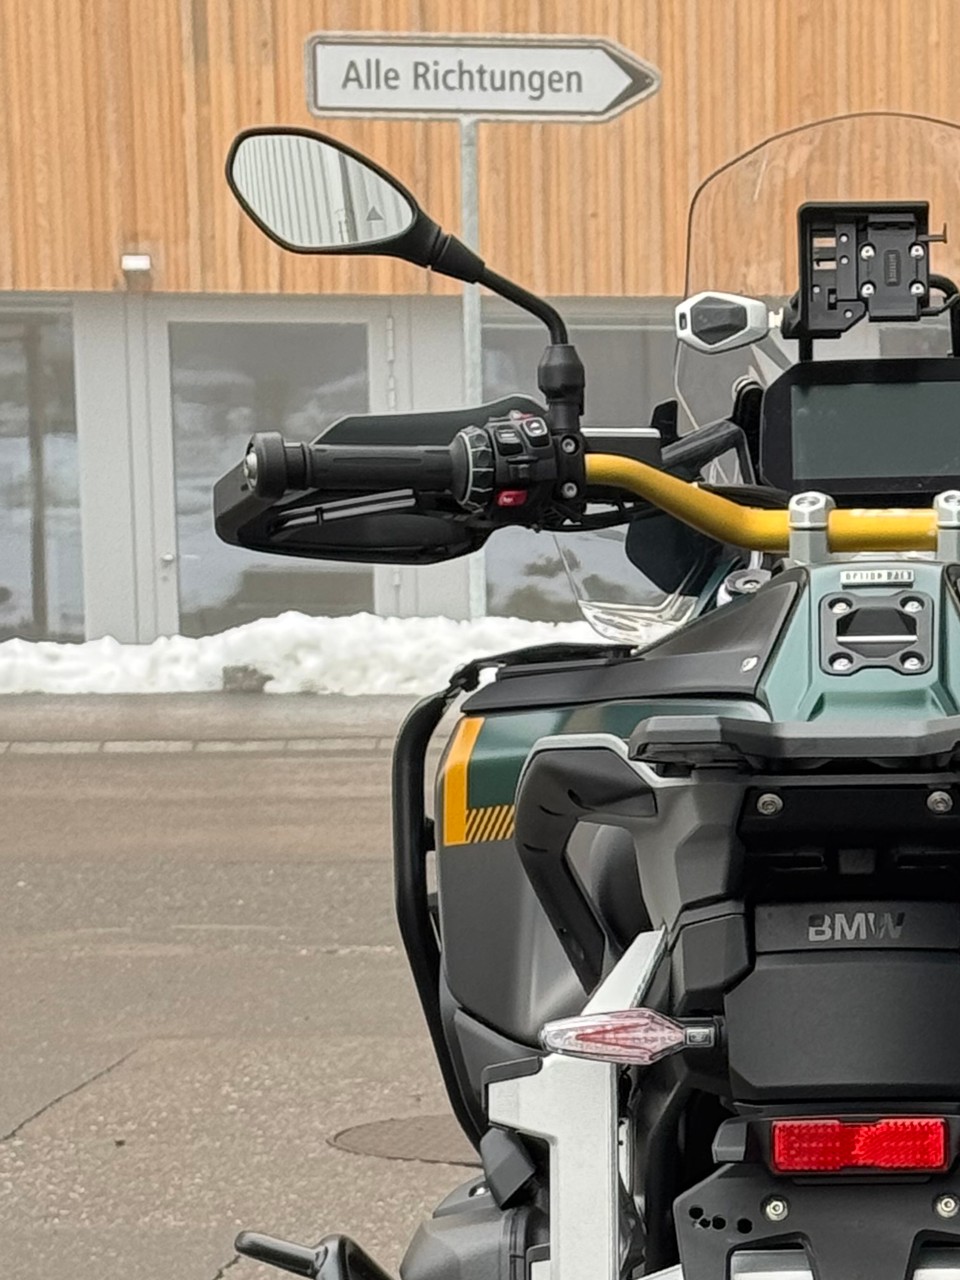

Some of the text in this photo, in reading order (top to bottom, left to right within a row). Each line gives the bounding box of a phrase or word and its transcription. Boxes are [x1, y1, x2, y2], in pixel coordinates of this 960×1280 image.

[341, 58, 583, 101] Alle Richtungen
[808, 912, 906, 942] BMW
